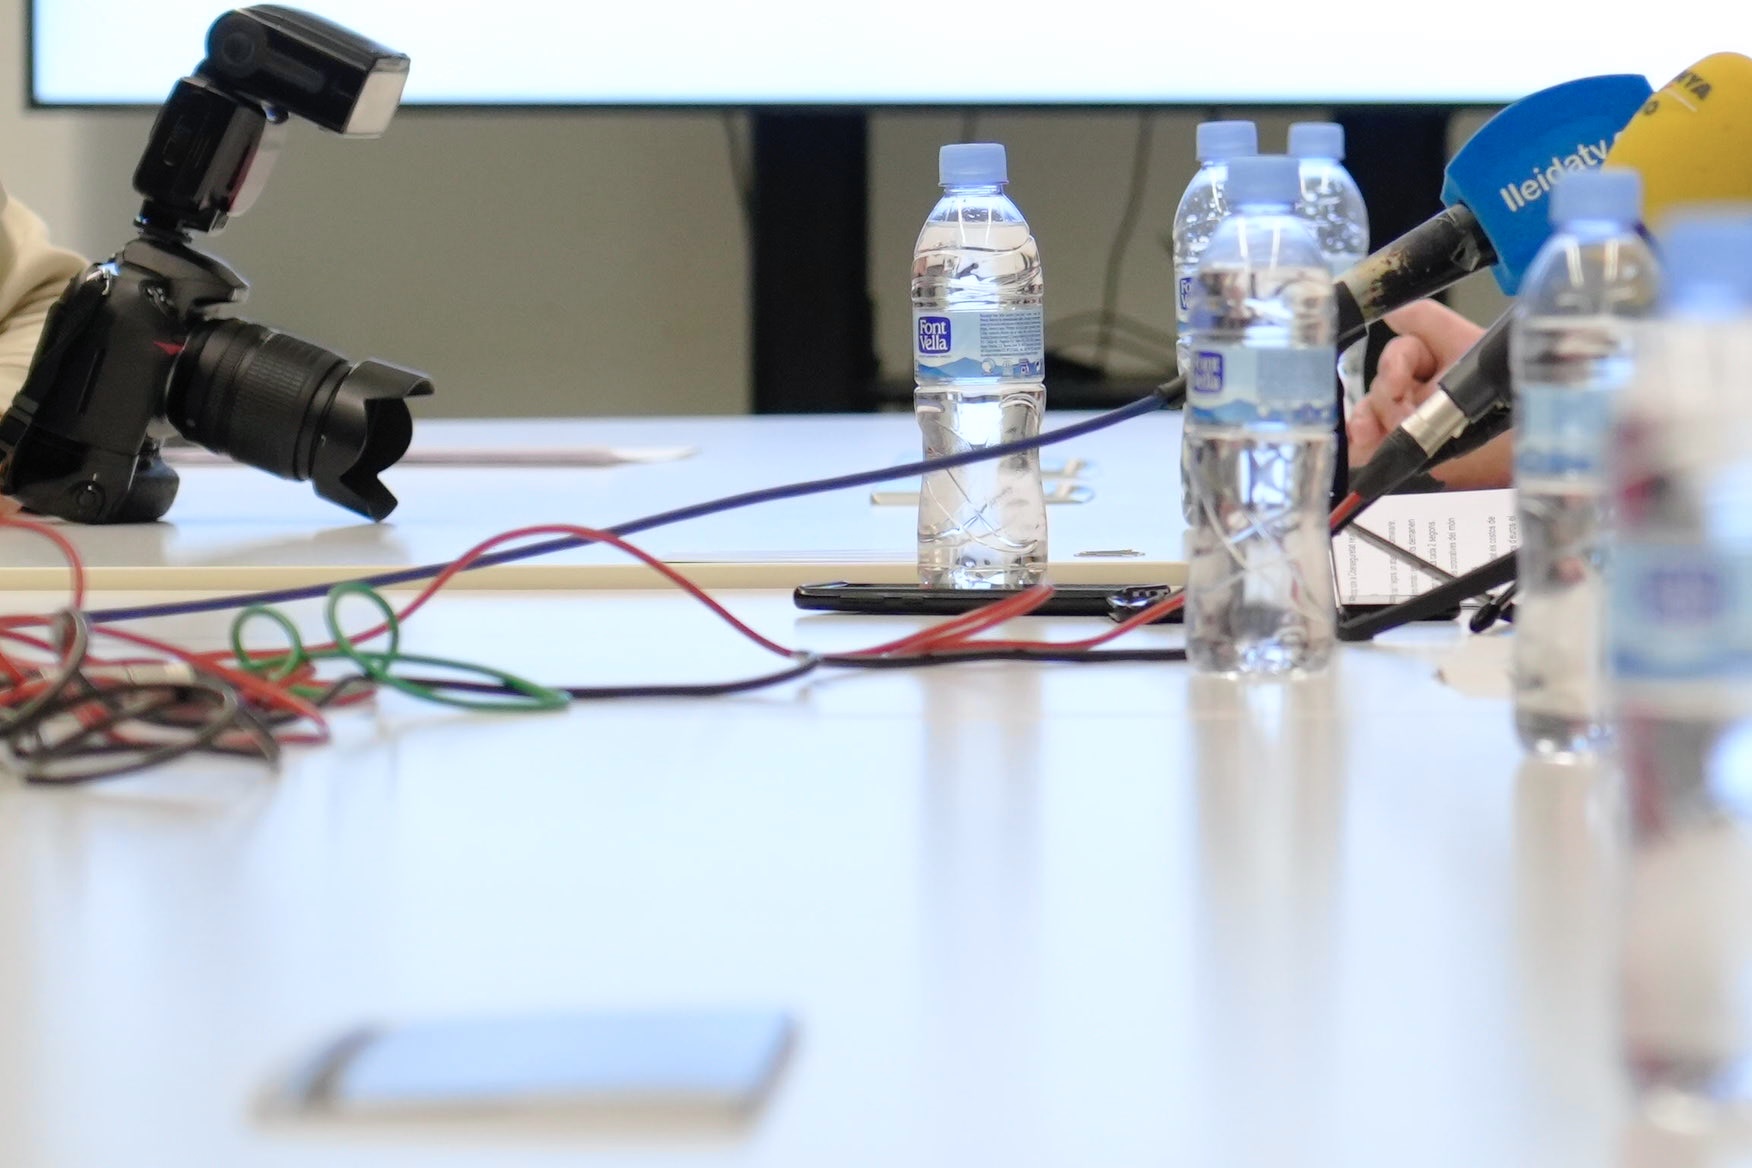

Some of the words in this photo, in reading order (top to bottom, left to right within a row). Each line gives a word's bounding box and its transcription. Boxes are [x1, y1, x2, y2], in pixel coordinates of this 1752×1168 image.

[1500, 139, 1609, 212] lleidatv
[920, 319, 947, 335] Font
[920, 334, 948, 351] Vella
